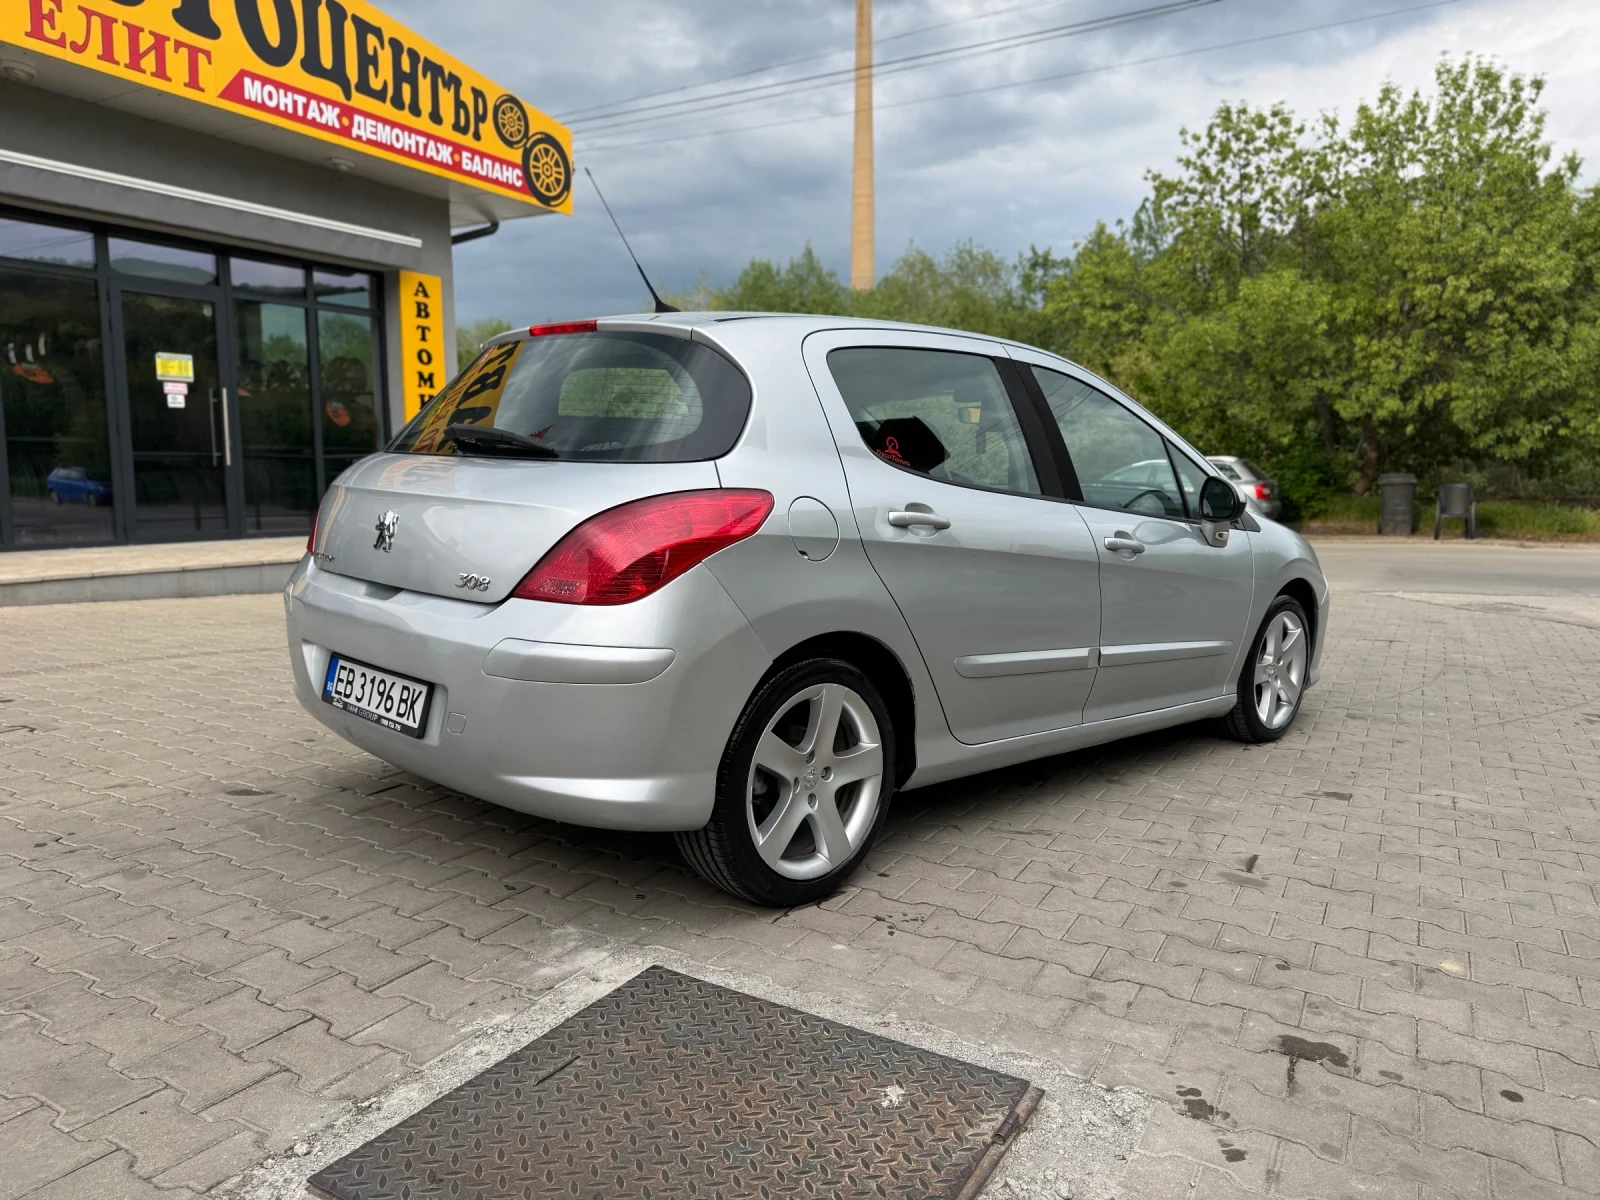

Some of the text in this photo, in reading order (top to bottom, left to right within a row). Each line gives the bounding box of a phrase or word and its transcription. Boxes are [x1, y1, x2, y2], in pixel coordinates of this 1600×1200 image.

[25, 0, 212, 93] ЕЛИТ
[108, 0, 488, 142] ОЦЕНТЪР
[243, 76, 523, 187] МОНТАЖ ДЕМОНТАЖ БАЛАНС
[455, 573, 490, 592] 308
